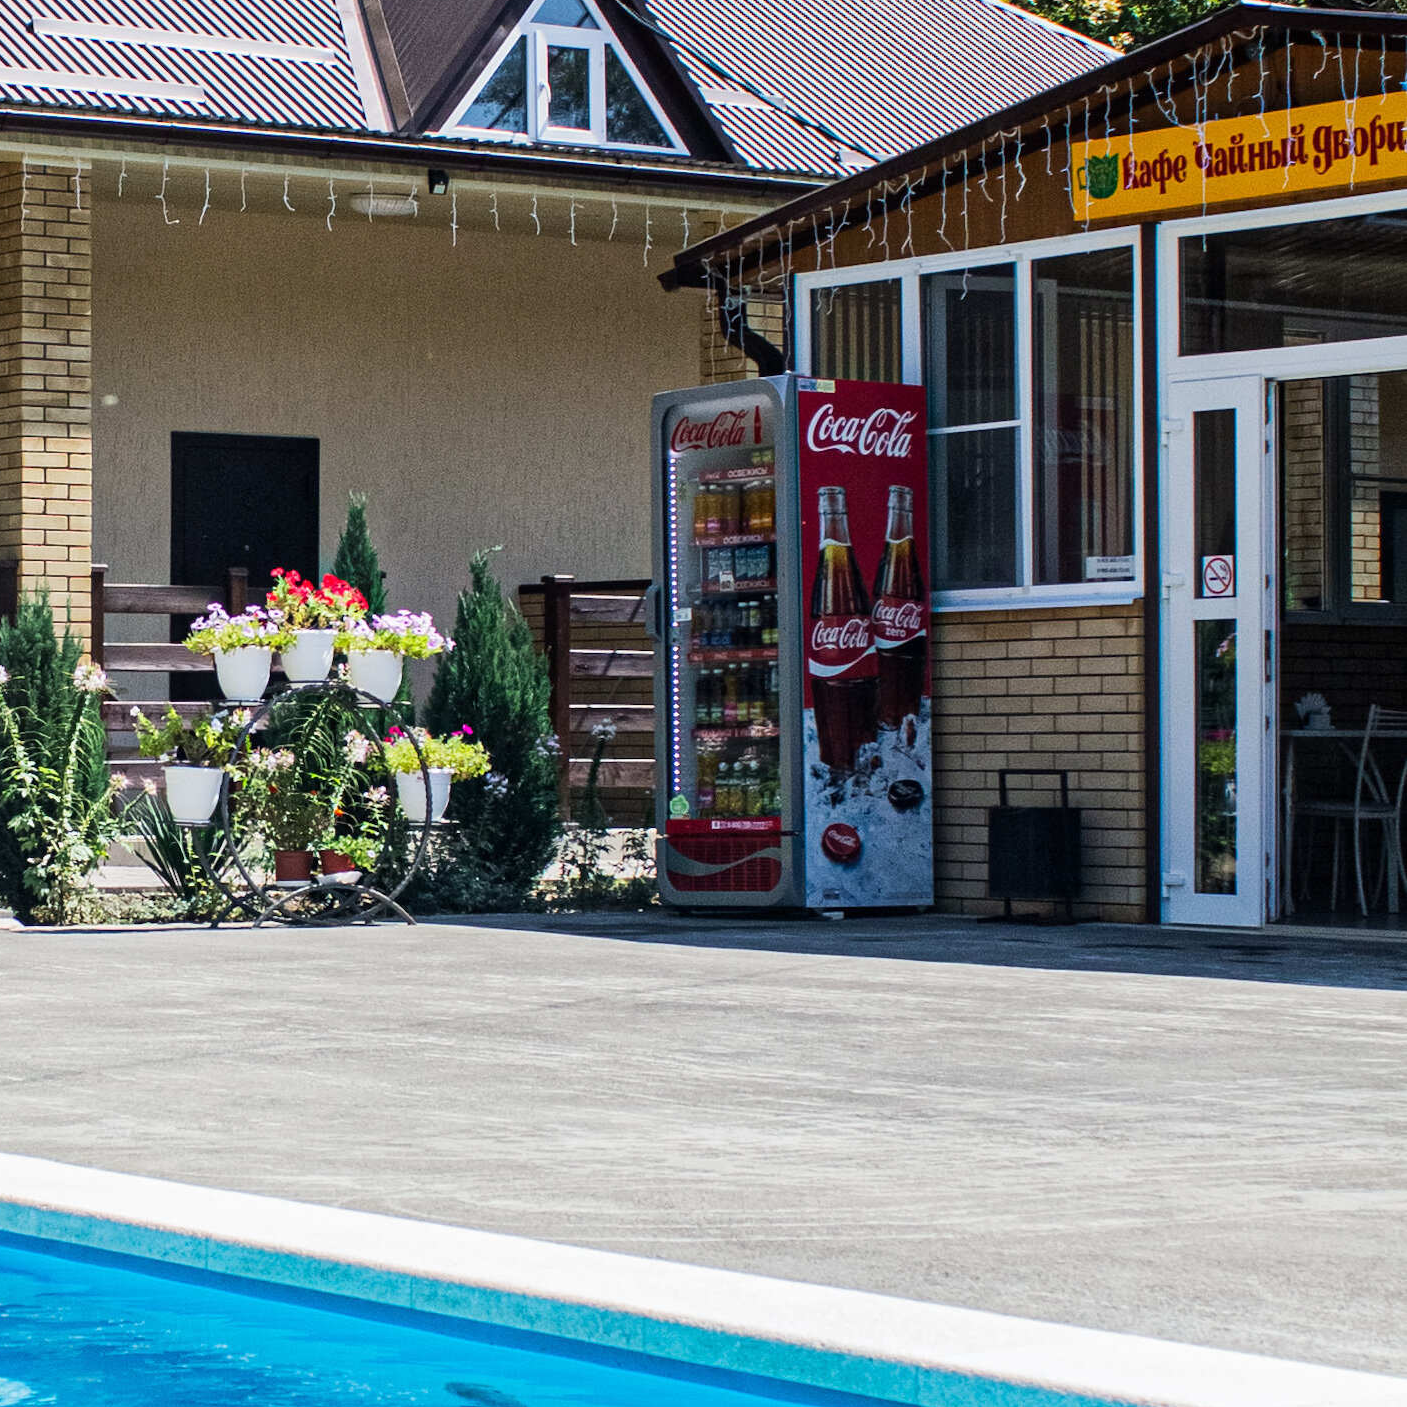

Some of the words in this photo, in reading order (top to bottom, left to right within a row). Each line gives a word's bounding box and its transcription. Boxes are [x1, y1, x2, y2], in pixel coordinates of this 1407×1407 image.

[1122, 148, 1188, 194] Кафе
[1193, 124, 1309, 178] Чайный
[671, 409, 749, 452] Coca-Cola
[807, 403, 918, 458] Coca-Cola
[872, 599, 924, 629] Coca-Cola
[885, 627, 906, 638] zero
[812, 618, 870, 651] Coca-Cola
